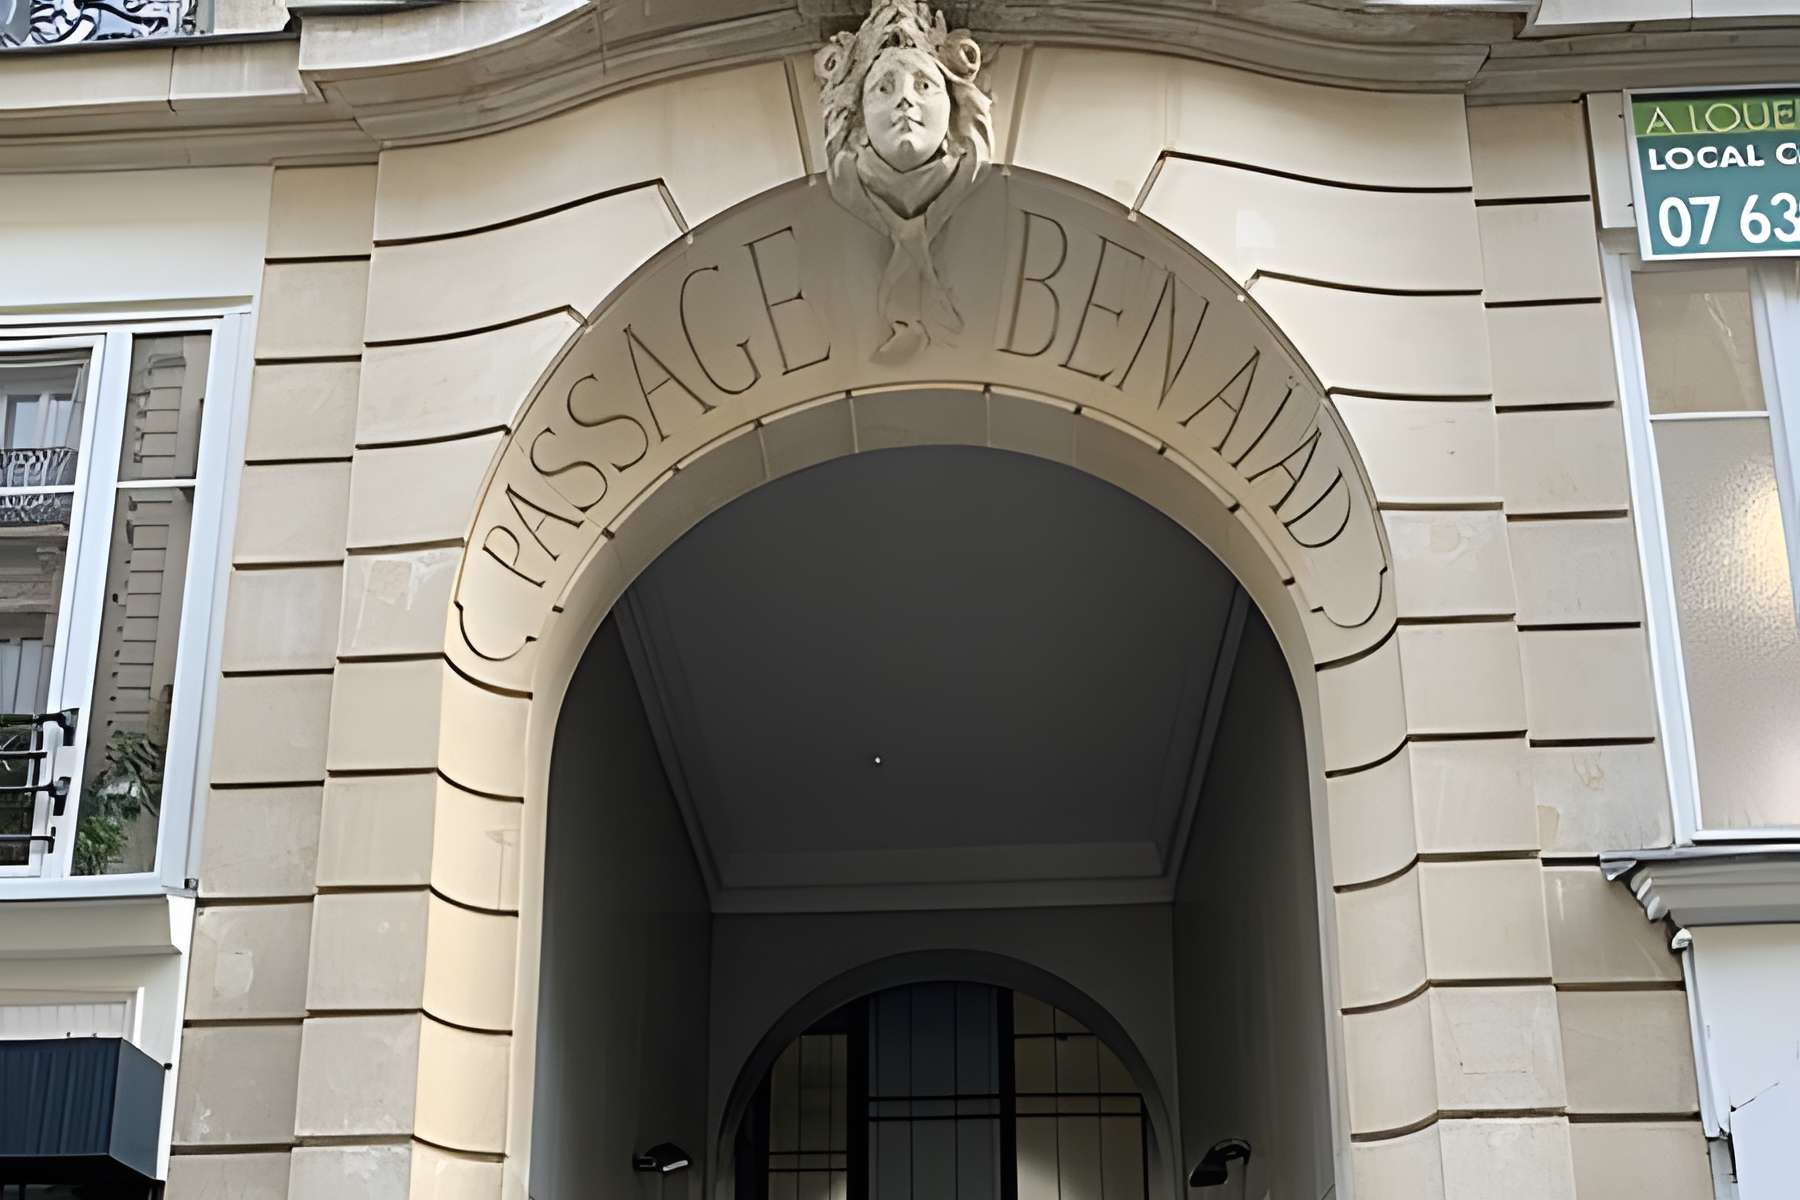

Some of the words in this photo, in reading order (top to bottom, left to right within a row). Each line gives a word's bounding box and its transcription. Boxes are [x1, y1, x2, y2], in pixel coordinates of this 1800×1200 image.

[1646, 107, 1676, 134] A
[1688, 100, 1800, 133] LOUE
[1648, 144, 1765, 171] LOCAL
[1658, 195, 1721, 248] 07
[1740, 192, 1800, 244] 63
[481, 226, 831, 588] PASSAGE
